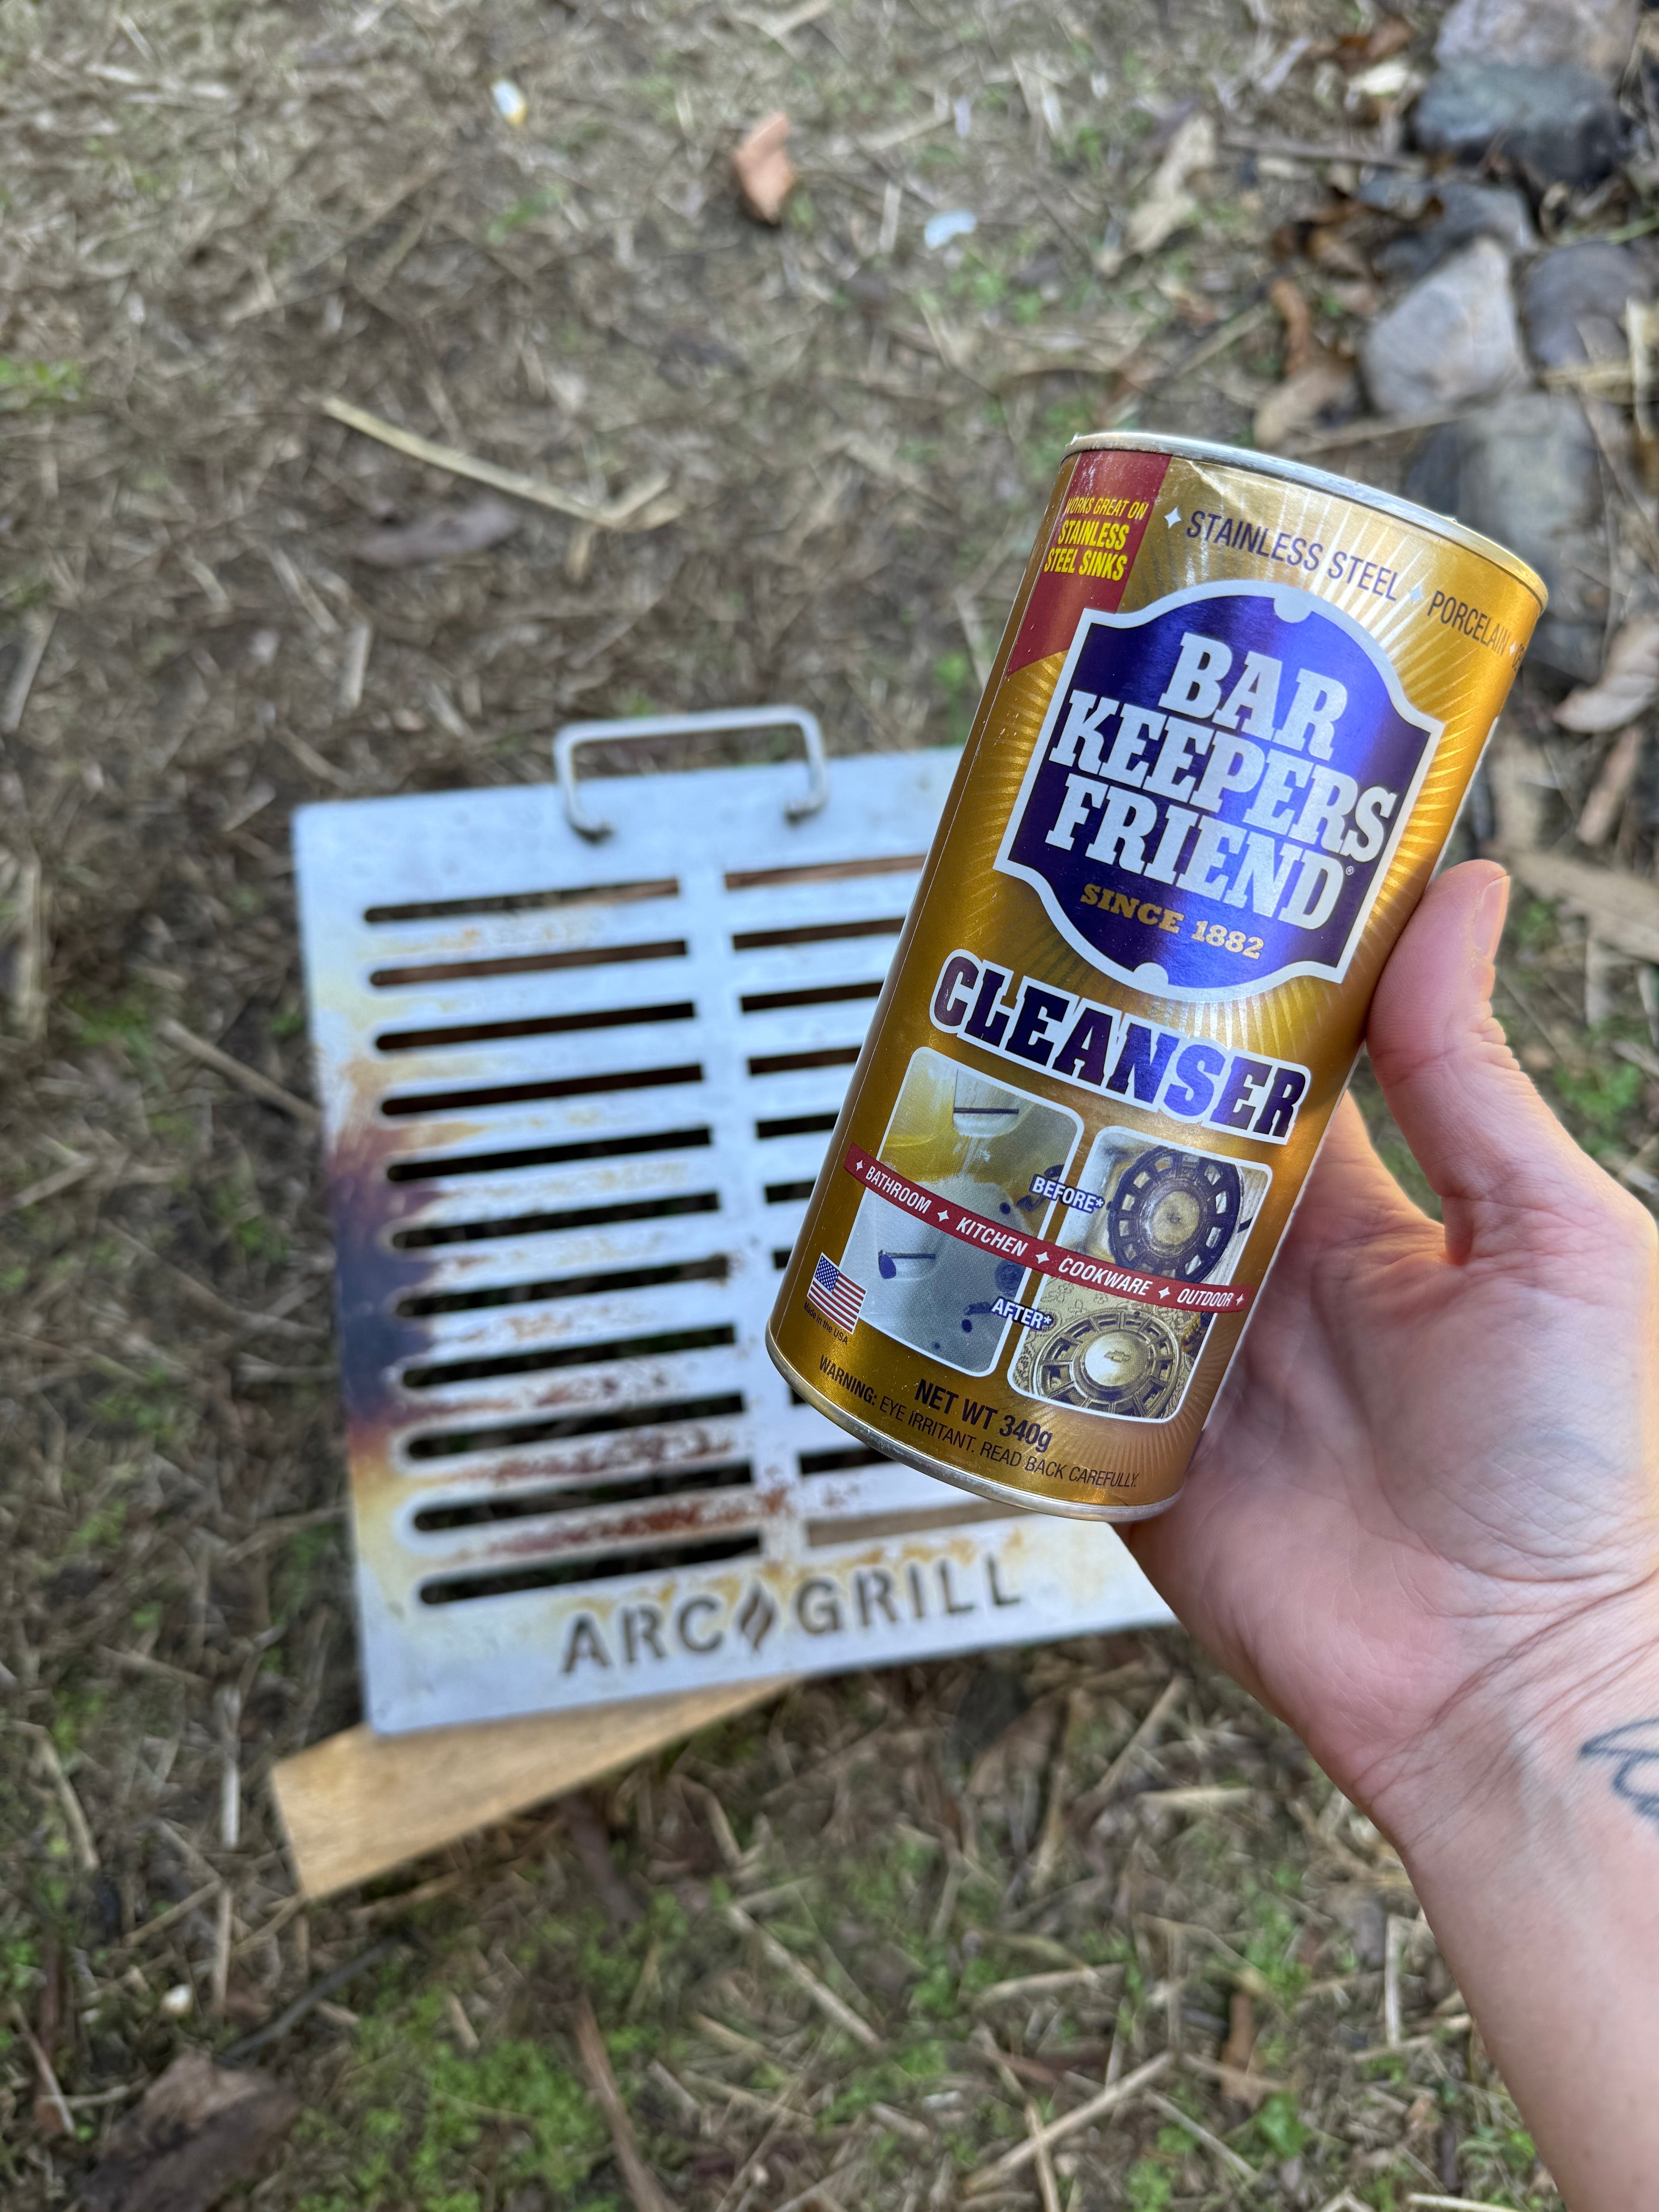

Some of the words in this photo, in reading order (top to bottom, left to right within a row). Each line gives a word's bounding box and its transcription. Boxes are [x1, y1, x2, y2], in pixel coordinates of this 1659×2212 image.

[1044, 548, 1078, 574] STEEL
[1079, 550, 1128, 581] SINKS
[1058, 520, 1130, 551] STAINLESS
[1065, 497, 1095, 514] WORKS
[1092, 498, 1130, 517] GREAT
[1127, 501, 1149, 520] ON
[1186, 511, 1323, 572] STAINLESS
[1328, 552, 1398, 601] STEEL
[1427, 590, 1511, 658] PORCELAIN
[1158, 632, 1347, 761] BAR
[1048, 690, 1396, 862] KEEPERS
[1080, 884, 1185, 934] SINCE
[1191, 920, 1266, 960] 1882
[933, 955, 1307, 1138] CLEANSER
[865, 1166, 932, 1214] BATHROOM
[955, 1216, 1029, 1257] KITCHEN
[1058, 1258, 1153, 1296] COOKWARE
[1176, 1288, 1233, 1307] OUTDOOR
[804, 1301, 816, 1319] Made
[823, 1319, 833, 1333] the
[833, 1328, 848, 1345] USA
[819, 1354, 878, 1406] WARNING:
[879, 1395, 907, 1422] EYE
[908, 1410, 977, 1453] IRRITANT.
[979, 1441, 1022, 1467] READ
[1024, 1455, 1068, 1479] BACK
[1068, 1466, 1140, 1487] CAREFULLY.
[914, 1379, 959, 1415] NET
[962, 1398, 998, 1430] WT
[999, 1415, 1053, 1453] 340g
[561, 1595, 725, 1673] ARC
[795, 1554, 1023, 1635] GRILL
